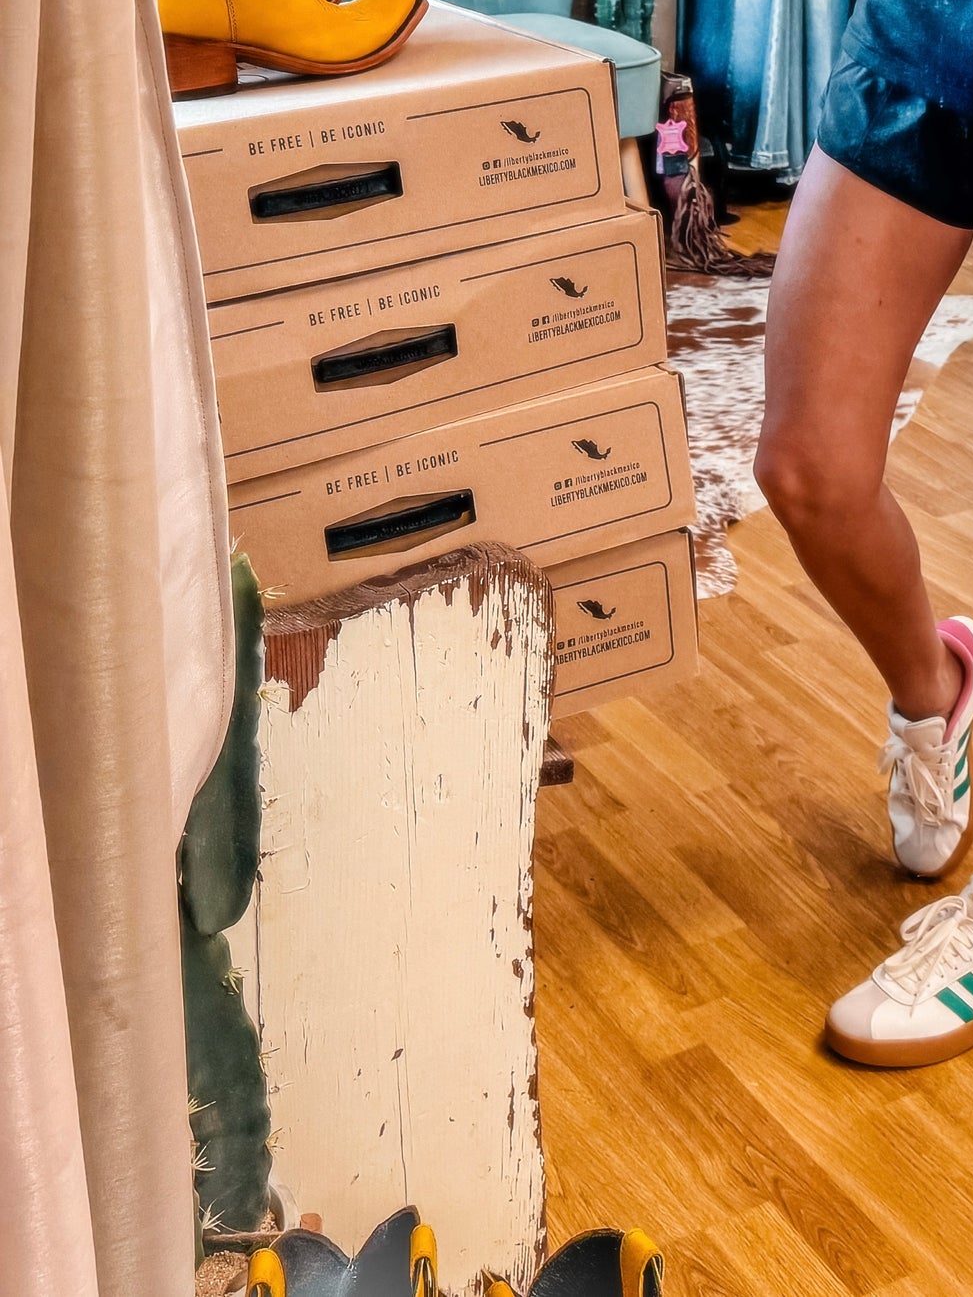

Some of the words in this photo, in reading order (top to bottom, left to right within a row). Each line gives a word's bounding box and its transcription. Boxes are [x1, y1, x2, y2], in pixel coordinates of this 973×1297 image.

[248, 140, 265, 156] BE
[270, 134, 303, 152] FREE
[321, 129, 337, 143] BE
[342, 120, 386, 140] ICONIC
[479, 158, 577, 187] LIBERTYBLACKMEXICO.COM
[309, 311, 325, 327] BE
[330, 303, 361, 322] FREE
[378, 295, 394, 311] BE
[398, 285, 441, 306] ICONIC
[528, 310, 622, 344] LIBERTYBLACKMEXICO.COM
[326, 479, 342, 495] BE
[347, 470, 379, 490] FREE
[396, 462, 412, 477] BE
[416, 450, 459, 472] ICONIC
[550, 471, 648, 507] LIBERTYBLACKMEXICO.COM
